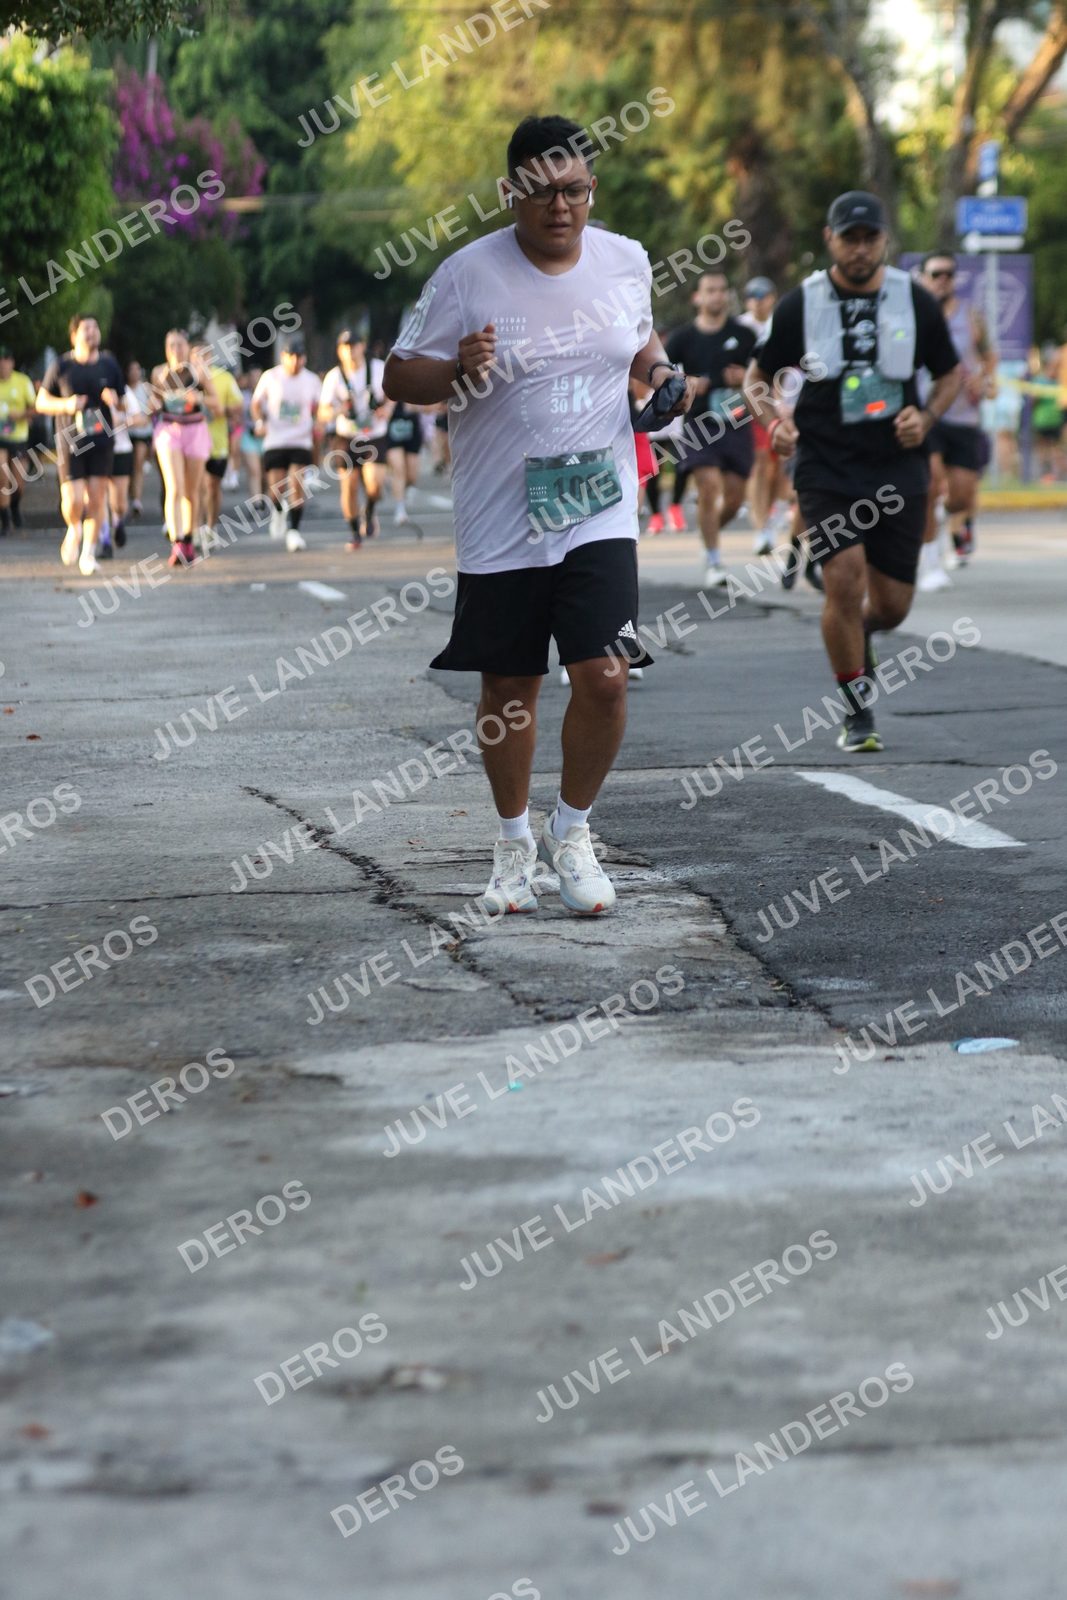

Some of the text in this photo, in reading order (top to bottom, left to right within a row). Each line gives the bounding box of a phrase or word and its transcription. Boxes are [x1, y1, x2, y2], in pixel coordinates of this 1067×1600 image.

[550, 397, 569, 414] 30
[551, 374, 597, 414] 15 K
